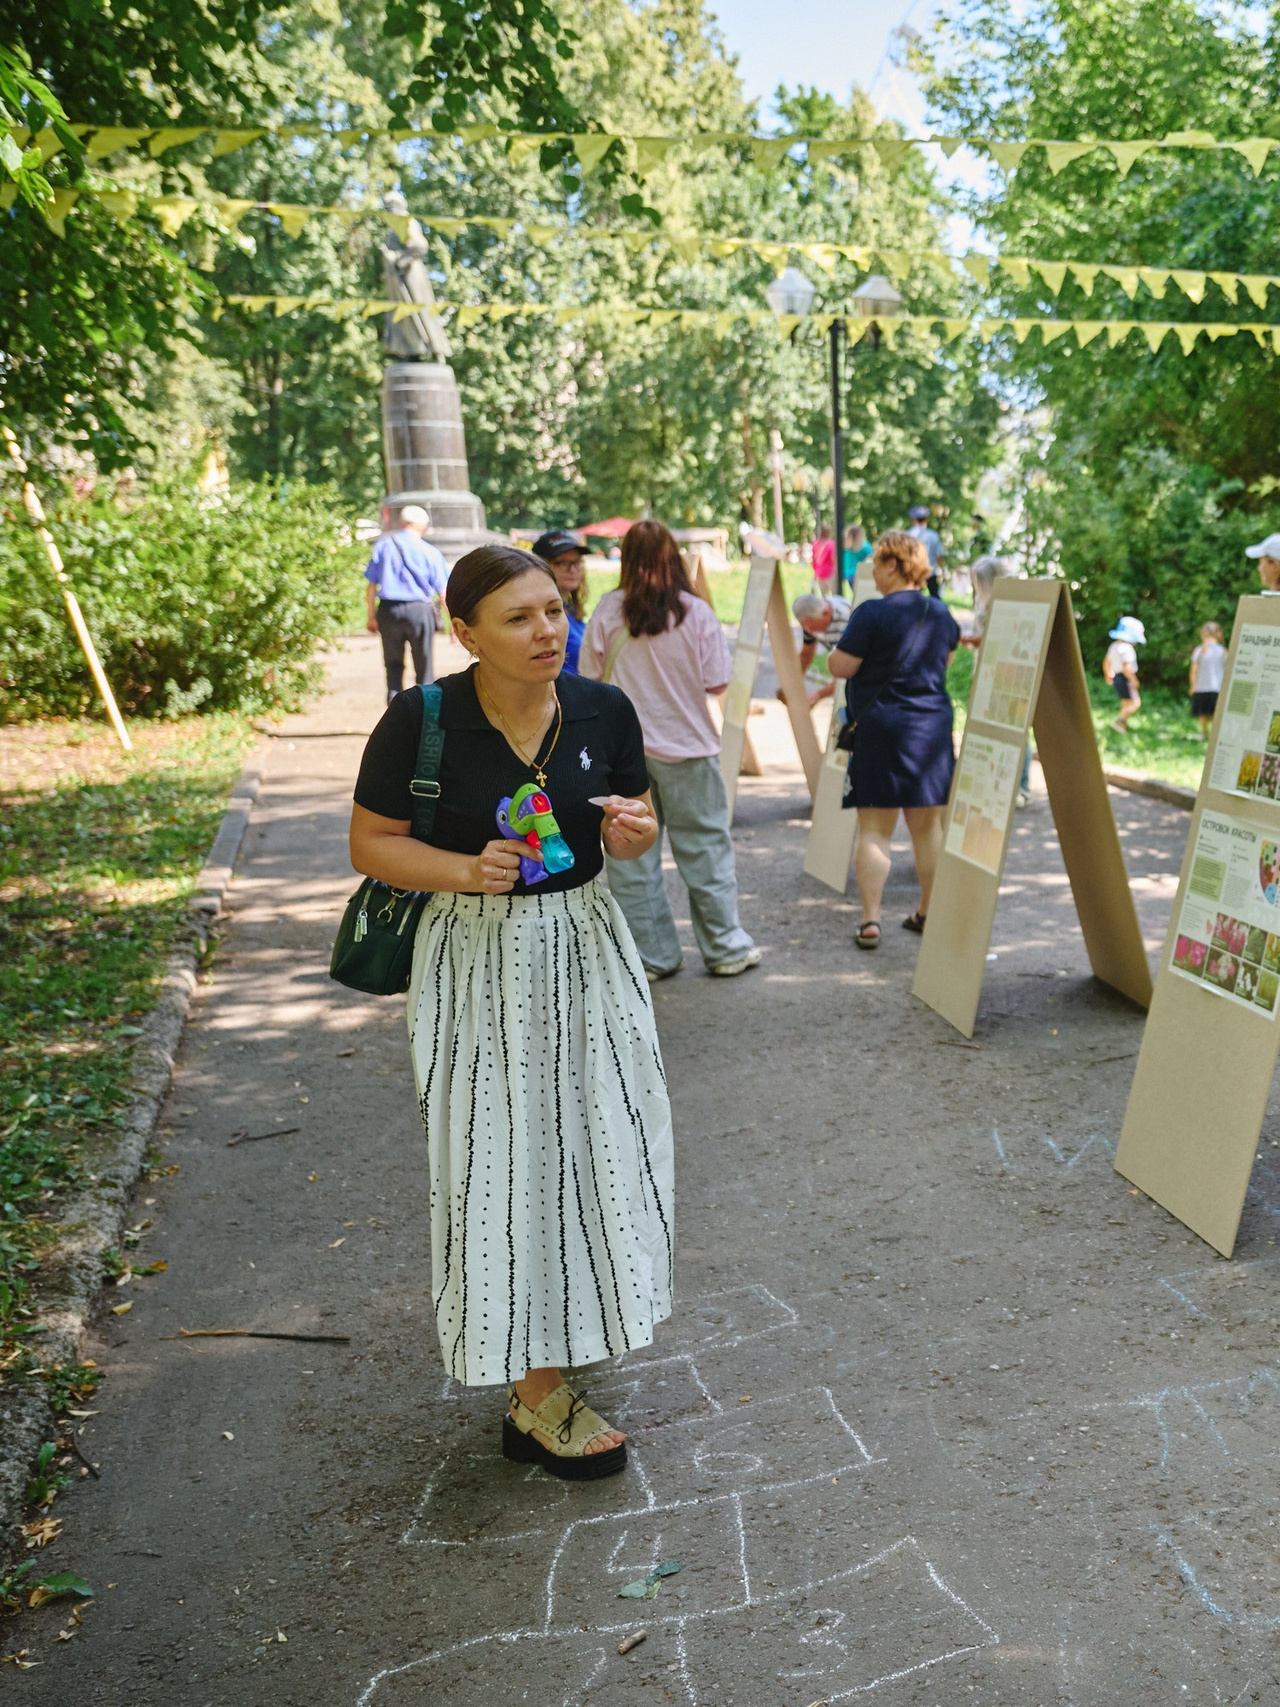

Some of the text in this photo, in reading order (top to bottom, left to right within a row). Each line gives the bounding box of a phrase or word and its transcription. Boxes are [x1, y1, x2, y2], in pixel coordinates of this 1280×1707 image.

[1240, 633, 1272, 646] ПАРАДНЫЙ
[1201, 818, 1257, 842] ОСТРОВОК КРАСОТЫ
